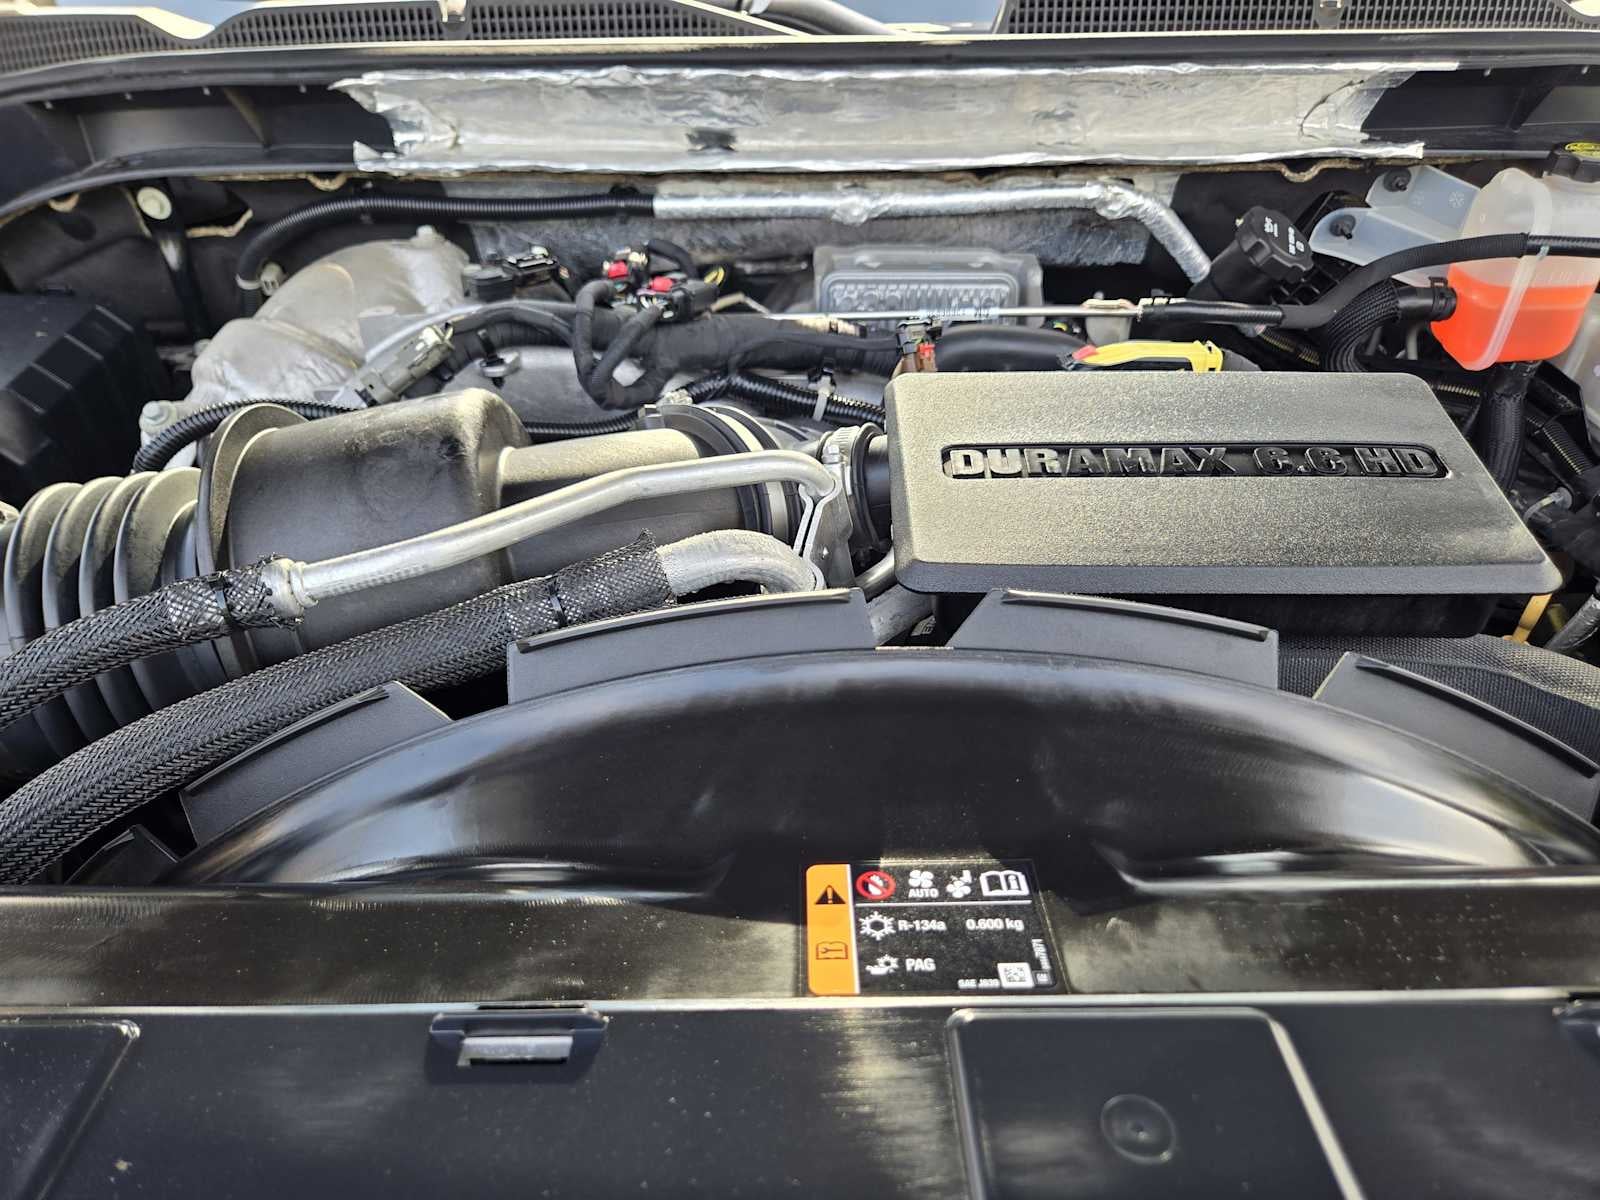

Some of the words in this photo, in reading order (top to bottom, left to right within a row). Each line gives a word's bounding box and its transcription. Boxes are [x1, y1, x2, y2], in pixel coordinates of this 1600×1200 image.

[949, 447, 1236, 477] DURAMAX
[1253, 447, 1348, 475] 6.6
[1353, 447, 1440, 476] HD
[908, 888, 939, 898] AUTO
[898, 919, 947, 931] R-134a
[966, 918, 1004, 930] 0.600
[1005, 918, 1025, 932] kg
[906, 958, 936, 972] PAG
